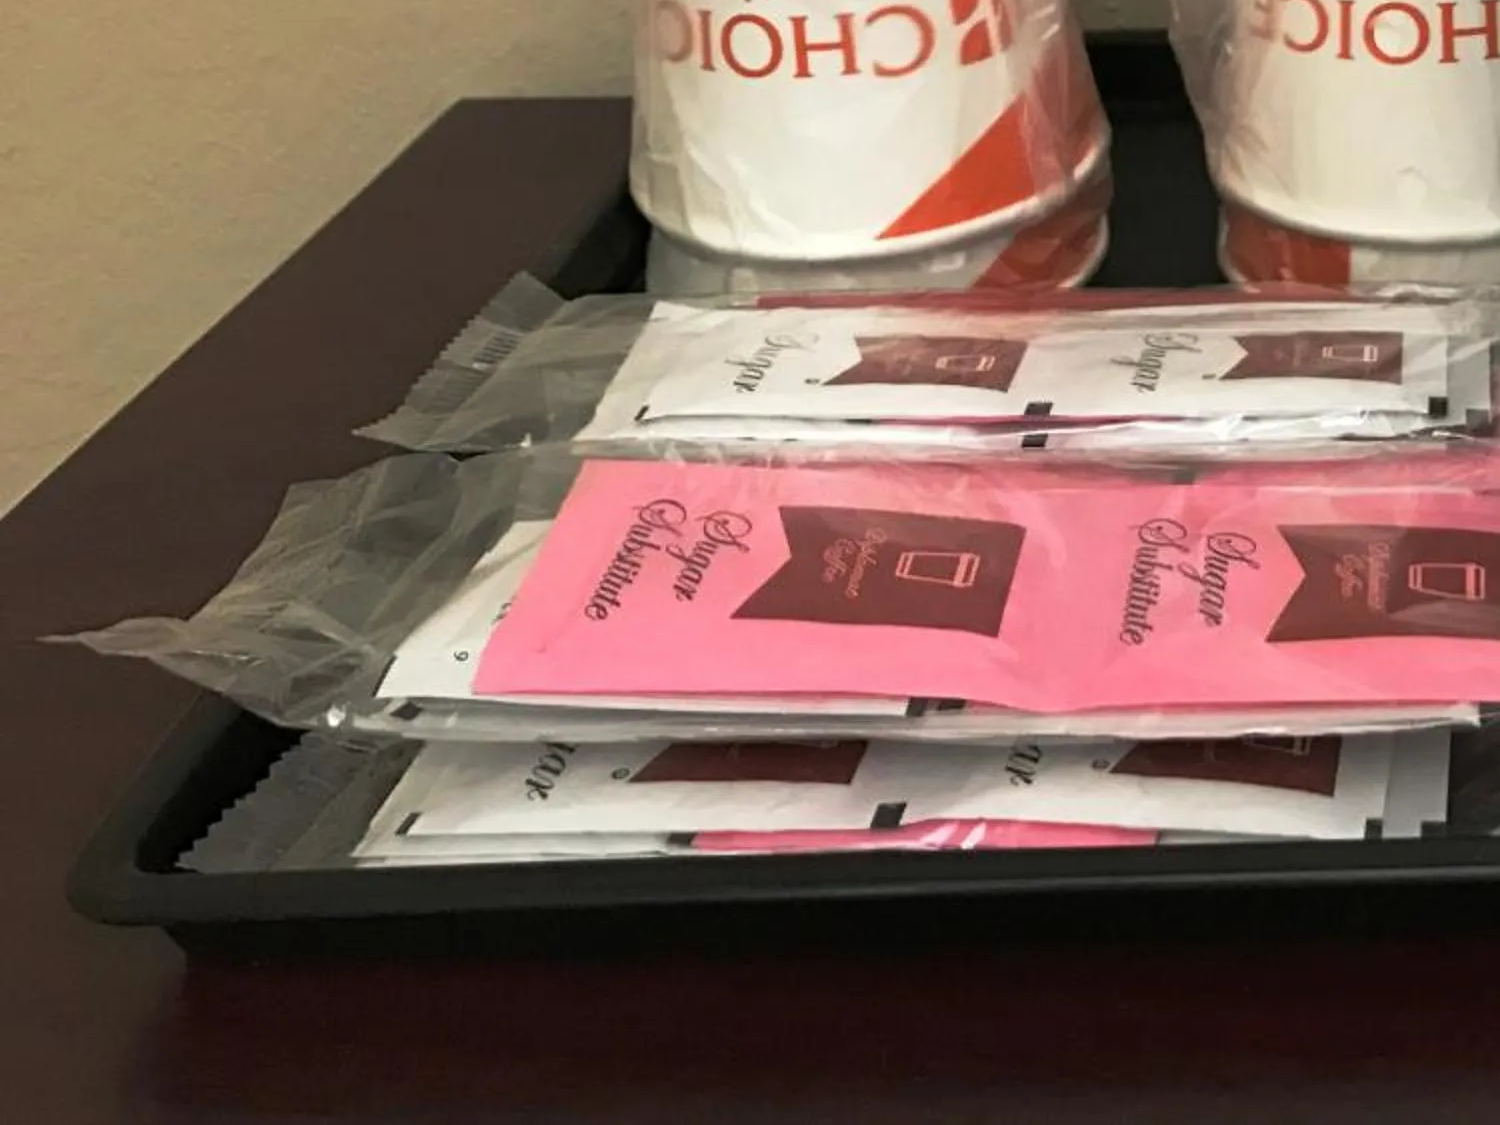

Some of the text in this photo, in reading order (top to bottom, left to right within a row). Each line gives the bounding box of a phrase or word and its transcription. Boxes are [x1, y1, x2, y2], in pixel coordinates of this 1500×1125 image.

[723, 332, 821, 393] Sugar
[1110, 332, 1204, 393] Sugar
[584, 498, 687, 621] Substitute
[665, 510, 753, 603] Sugar
[1119, 517, 1190, 646] Substitute
[1178, 532, 1261, 628] Sugar
